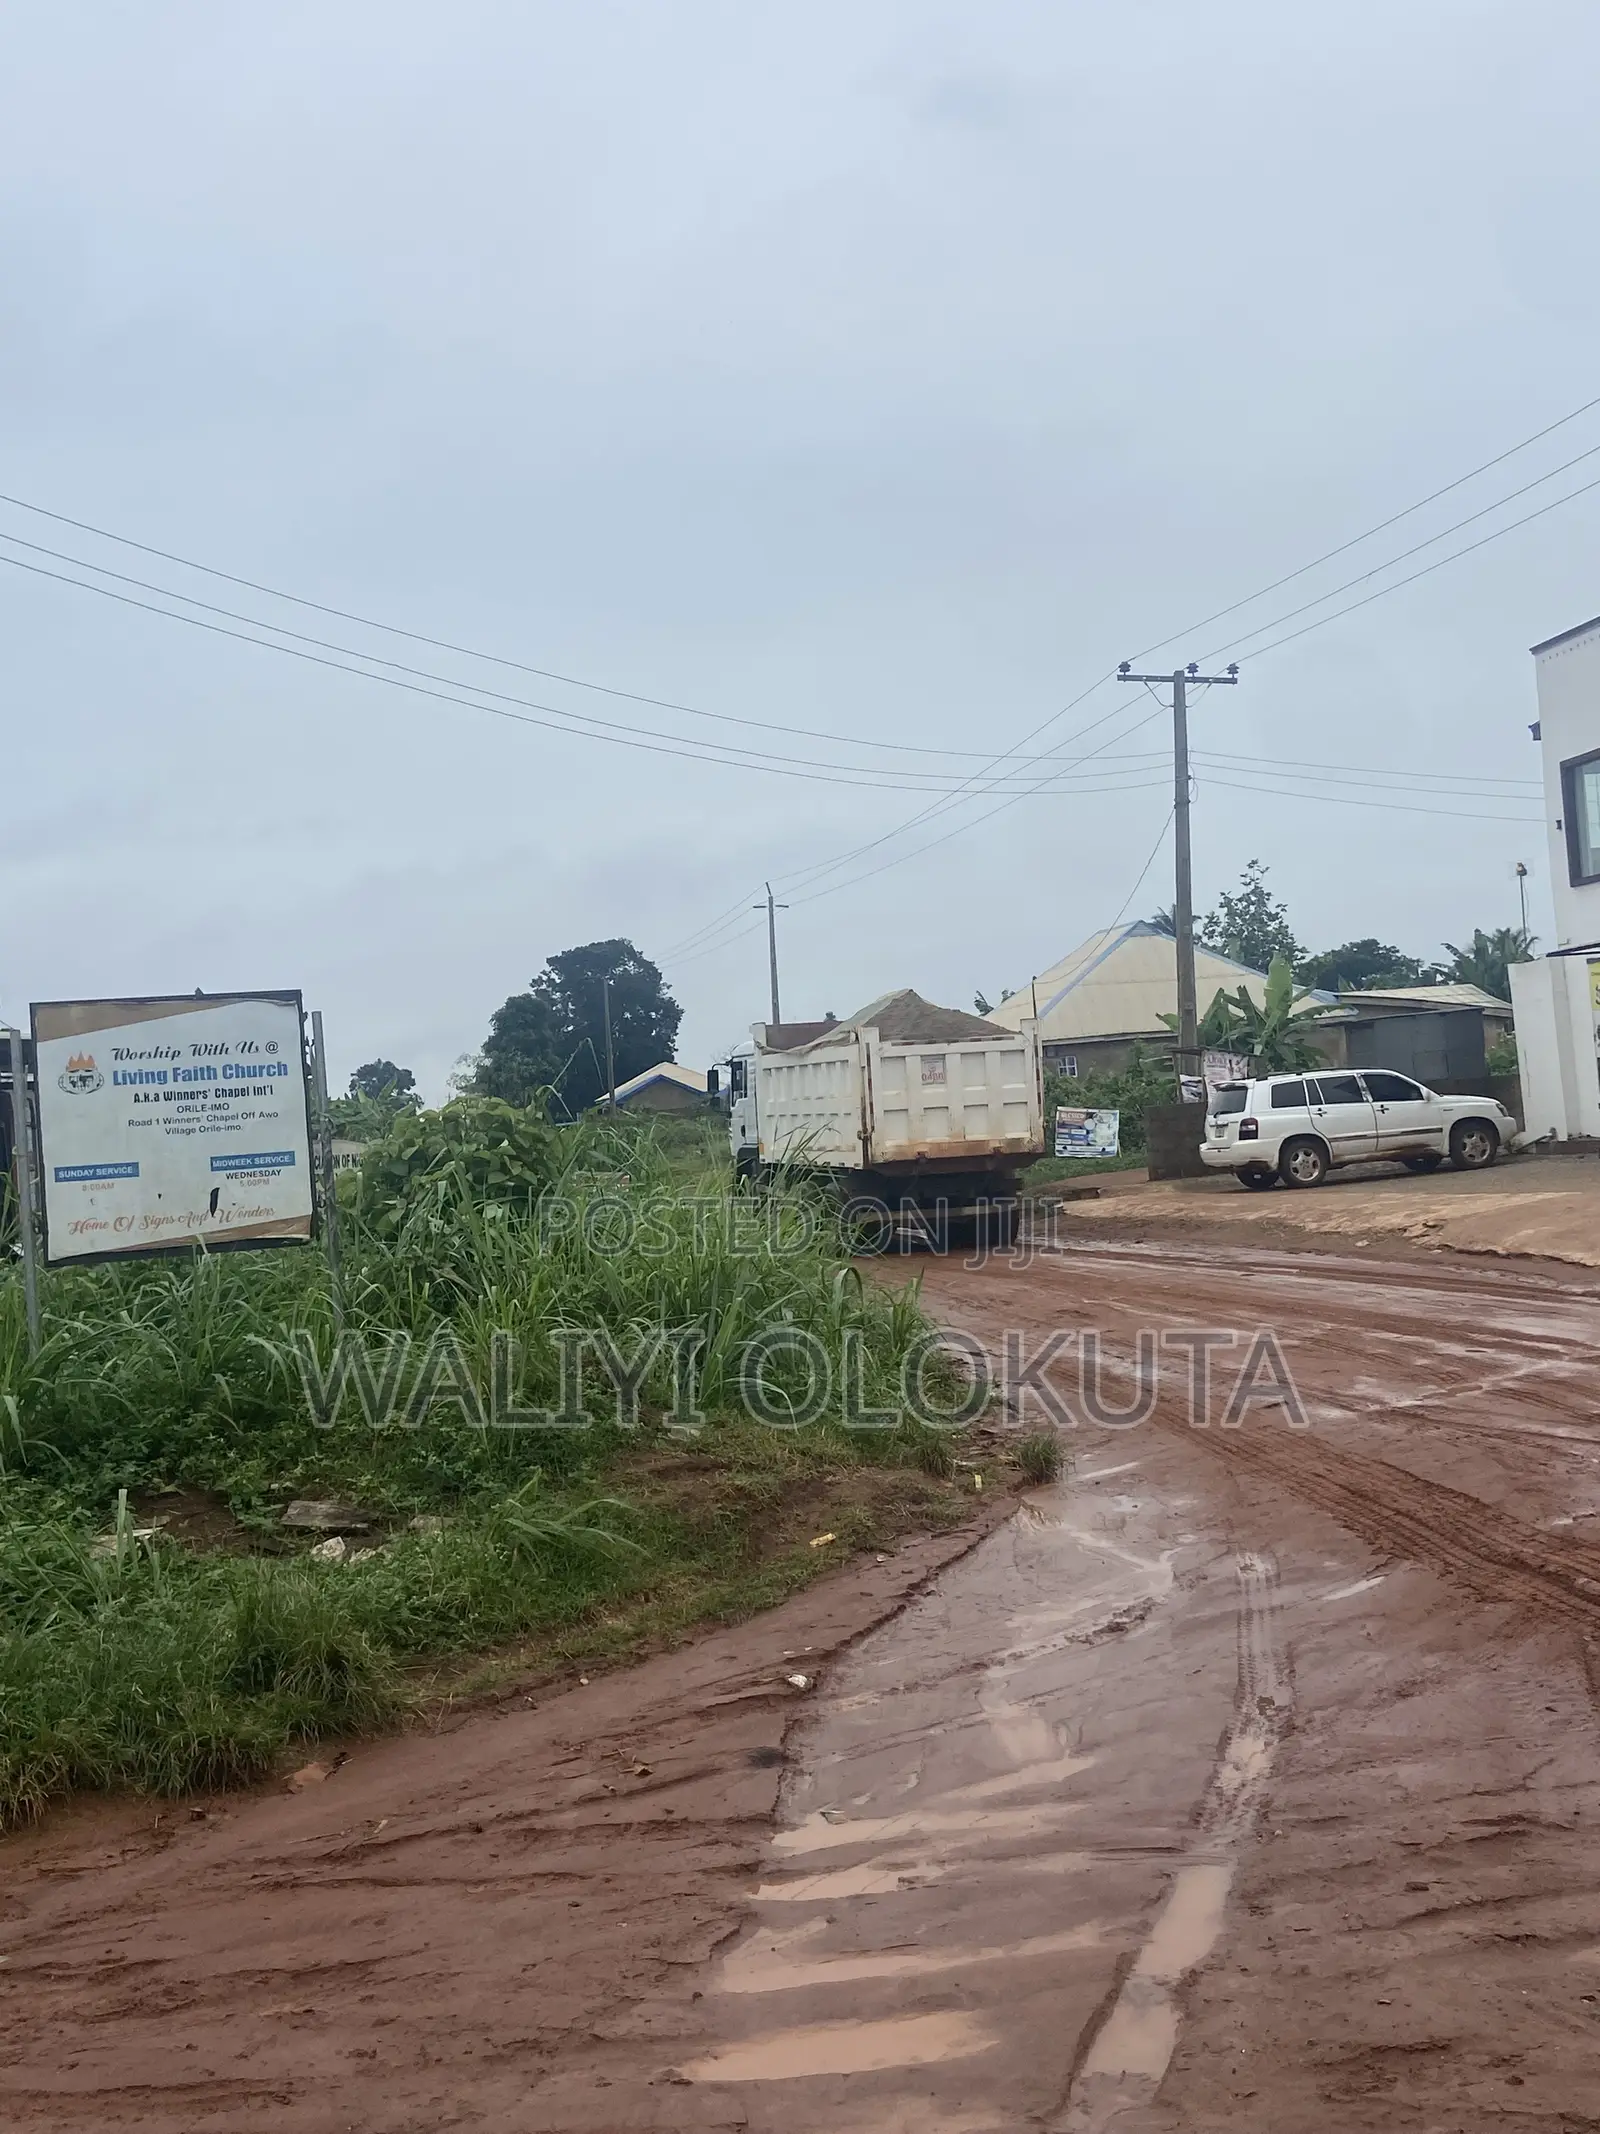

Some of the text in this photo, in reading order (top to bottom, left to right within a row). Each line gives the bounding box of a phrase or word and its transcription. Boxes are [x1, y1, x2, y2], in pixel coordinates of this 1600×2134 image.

[110, 1041, 279, 1061] Worship With Us @
[112, 1061, 288, 1086] Living Faith Church
[163, 1088, 211, 1102] Winners'
[215, 1085, 250, 1099] Chapel
[176, 1102, 230, 1114] ORILE-IMO
[128, 1111, 279, 1127] Road 1 Winners' Chapel Off Awo
[164, 1124, 196, 1135] Village
[212, 1155, 291, 1168] MIDWEEK SERVICE
[58, 1165, 134, 1179] SUNDAY SERVICE
[225, 1169, 282, 1180] WEDNESDAY
[67, 1204, 277, 1235] Home Of Signs And Wonders
